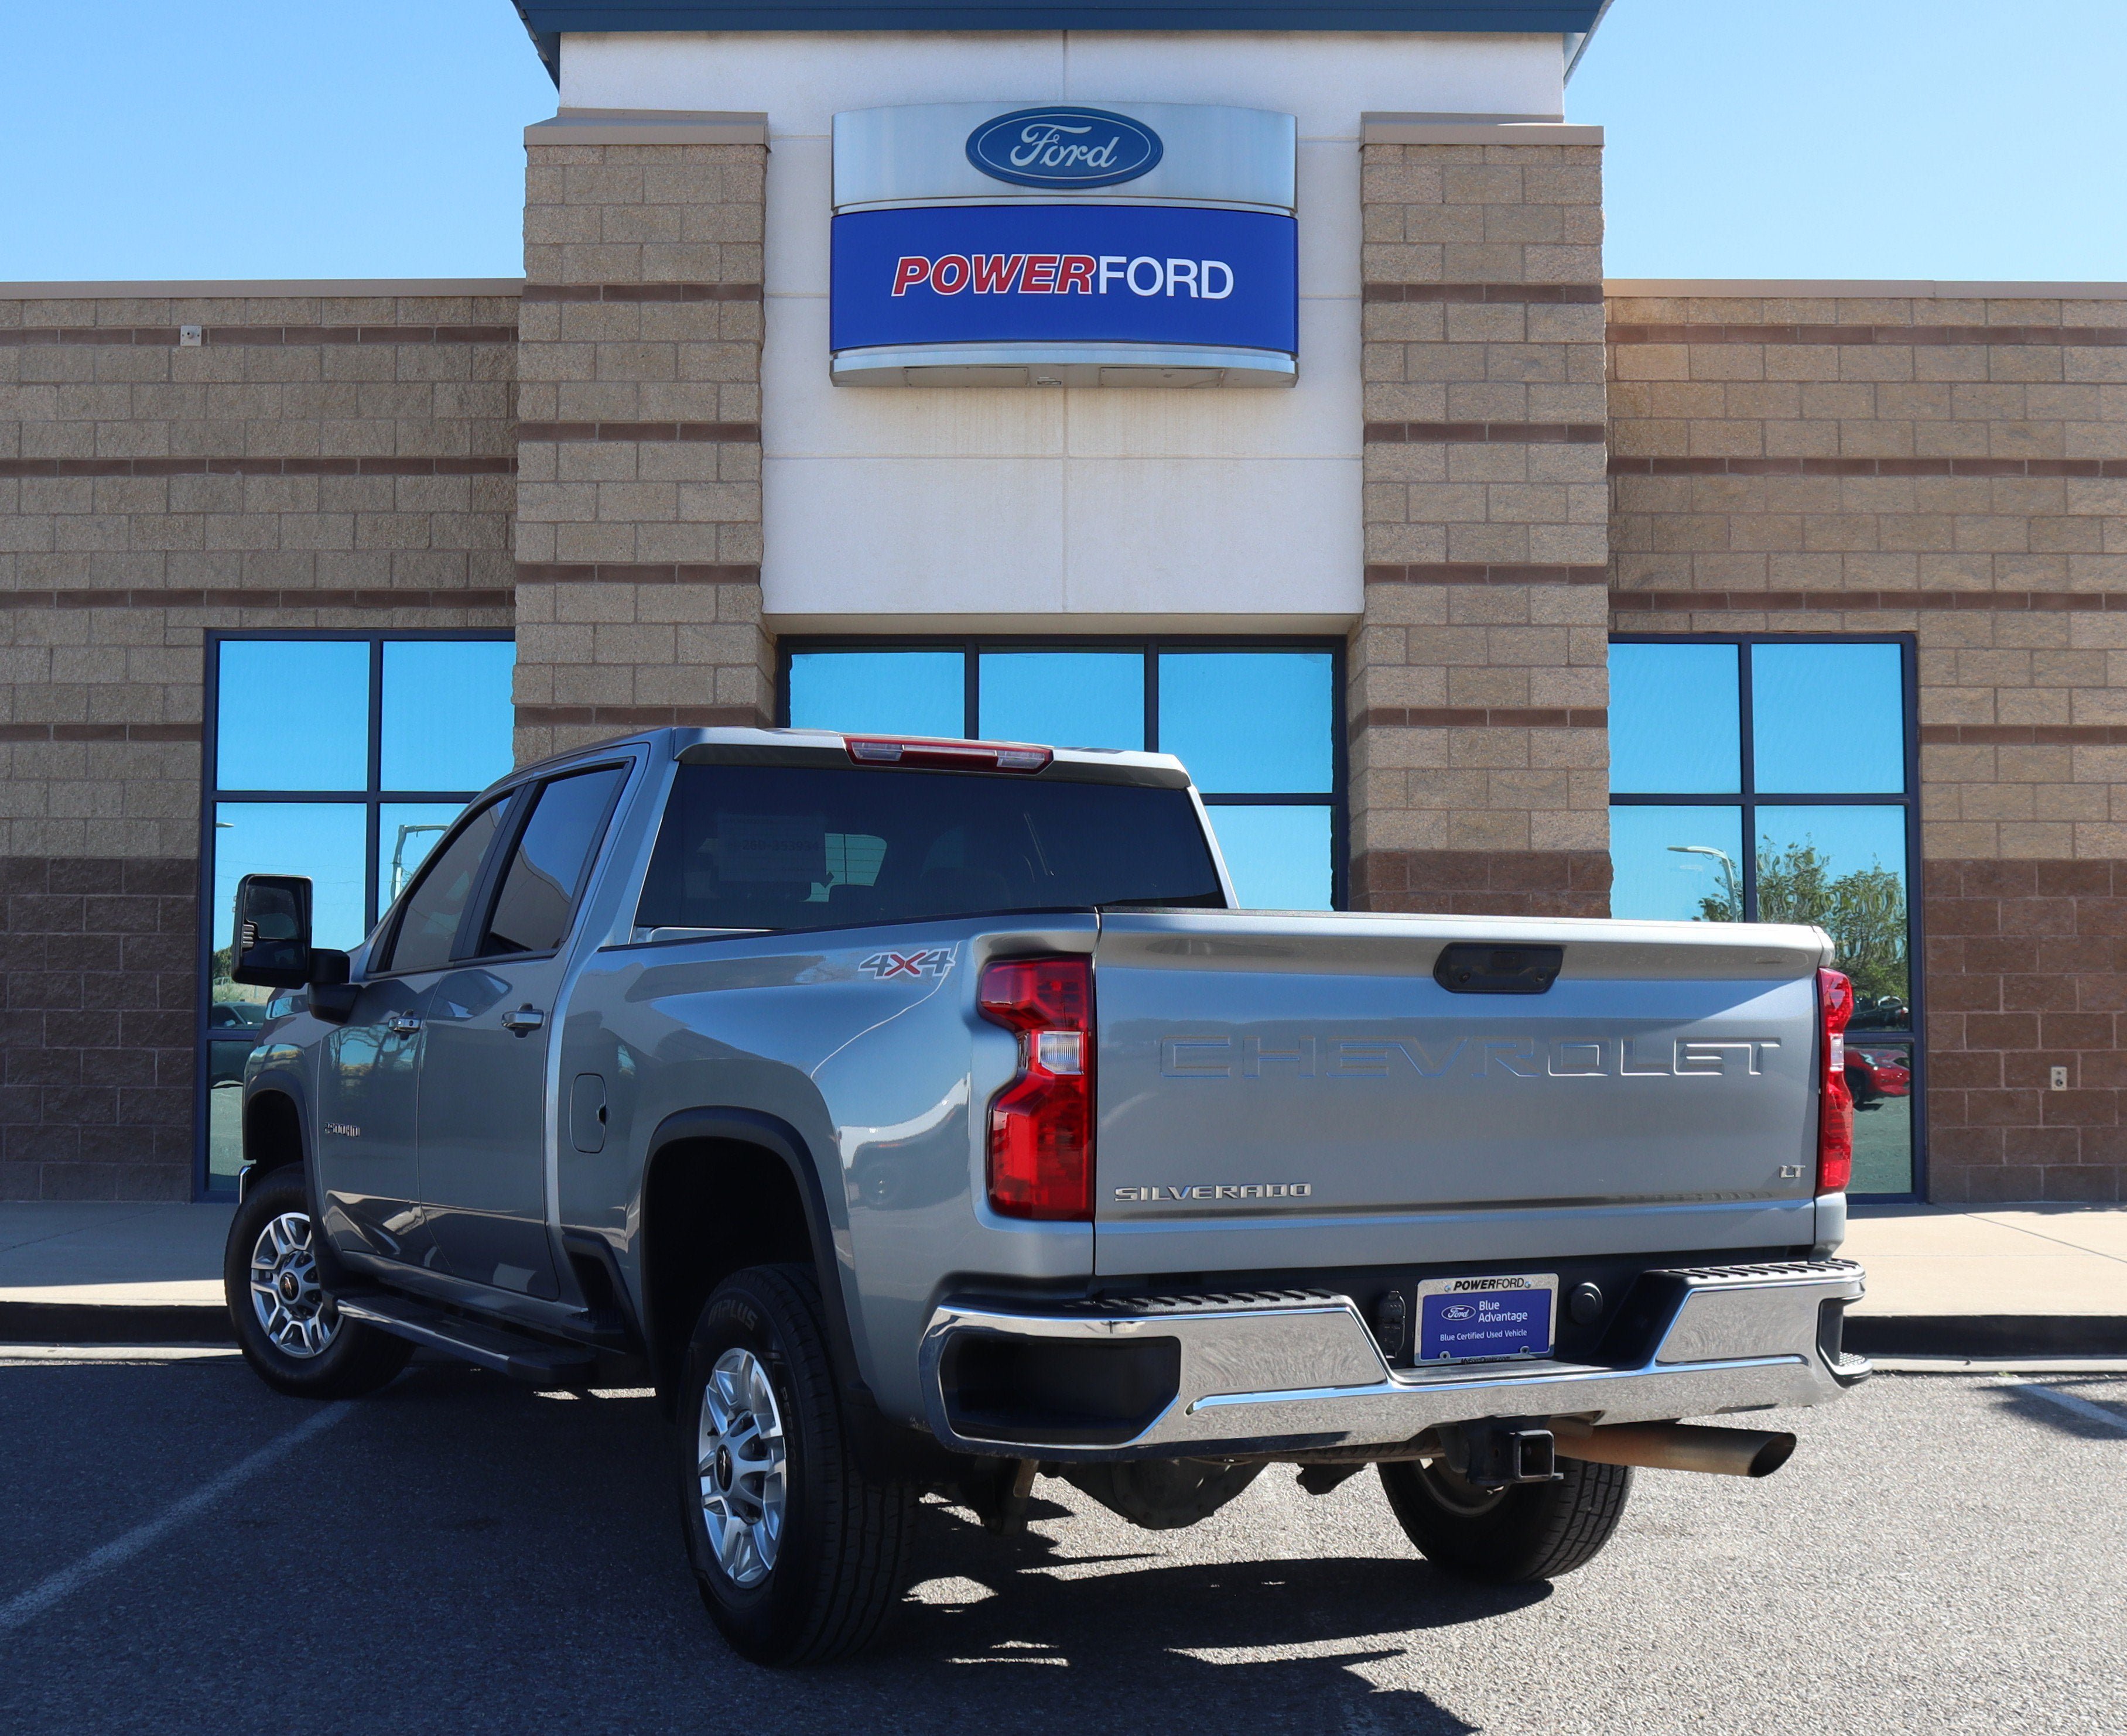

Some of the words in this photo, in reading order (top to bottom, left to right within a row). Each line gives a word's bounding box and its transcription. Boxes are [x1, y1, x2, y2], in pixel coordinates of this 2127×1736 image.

[1010, 123, 1120, 169] Ford
[891, 254, 1234, 299] POWERFORD
[1160, 1034, 1782, 1078] CHEVROLET
[1779, 1165, 1805, 1178] LT
[1114, 1182, 1312, 1201] SILVERADO
[1454, 1278, 1524, 1291] POWERFORD
[1479, 1300, 1500, 1311] Blue
[1448, 1307, 1469, 1318] Ford
[1478, 1311, 1528, 1323] Advantage
[1440, 1334, 1455, 1342] Blue
[1456, 1331, 1485, 1341] Certified
[1486, 1330, 1503, 1339] Used
[1504, 1328, 1527, 1337] Vehicle
